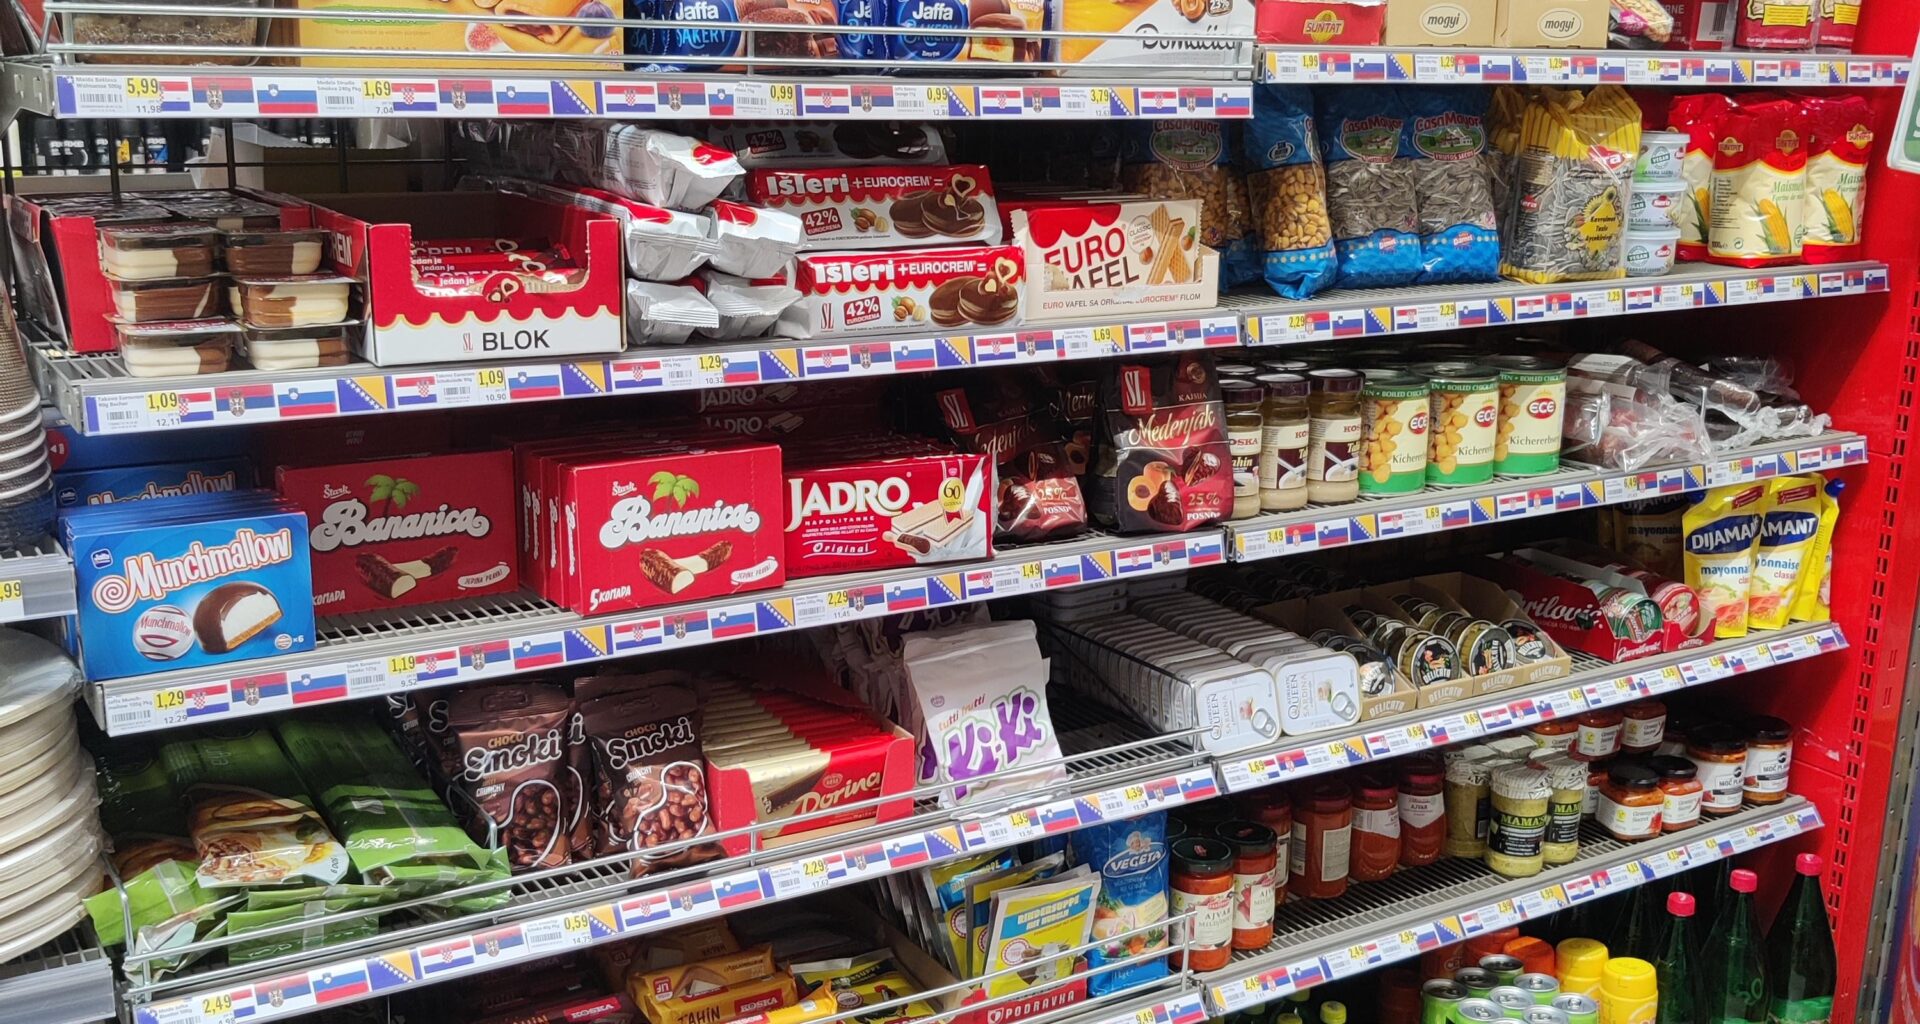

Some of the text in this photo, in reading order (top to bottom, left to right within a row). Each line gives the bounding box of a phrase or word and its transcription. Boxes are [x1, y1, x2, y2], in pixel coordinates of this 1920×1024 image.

[676, 1, 719, 21] Jaffa
[912, 1, 953, 21] Jaffa
[1305, 21, 1343, 34] SUNTAT
[1427, 12, 1461, 29] mogyi
[1544, 17, 1576, 32] mogyi
[126, 77, 160, 97] 5,99
[363, 80, 391, 97] 1,69
[770, 84, 794, 100] 0,99
[926, 87, 948, 102] 0,99
[1089, 88, 1109, 103] 3,79
[136, 105, 162, 114] 11,98
[1414, 111, 1482, 131] CasaMayor
[750, 131, 782, 147] 42%
[766, 173, 850, 195] Išleri
[804, 209, 839, 227] 42%
[1044, 226, 1126, 274] EURO
[421, 264, 455, 272] jedan je
[1072, 256, 1140, 289] AFEL
[440, 277, 475, 287] jedan je
[846, 298, 879, 317] 42%
[1042, 301, 1064, 310] EURO
[1065, 299, 1088, 309] VAFEL
[1089, 298, 1099, 307] SA
[1179, 292, 1201, 302] FILOM
[820, 302, 834, 331] SL
[1440, 304, 1455, 318] 2,29
[1289, 315, 1306, 329] 2,29
[482, 329, 551, 352] BLOK
[1093, 329, 1111, 342] 1,69
[699, 354, 722, 372] 1,29
[478, 369, 505, 387] 1,09
[1124, 370, 1147, 408] SL
[148, 391, 179, 410] 1,09
[1530, 402, 1555, 416] ECE
[943, 392, 968, 431] SL
[1476, 408, 1496, 424] ECE
[156, 417, 181, 428] 12,11
[1128, 404, 1216, 446] Medenjak
[1410, 415, 1428, 431] ECE
[1229, 437, 1258, 446] OSKA
[1232, 456, 1253, 467] ahin
[943, 480, 961, 500] 60
[784, 476, 911, 533] JADRO
[1424, 506, 1440, 520] 1,69
[310, 497, 491, 552] Bananica
[600, 495, 761, 549] Bananica
[805, 515, 875, 526] NAPOLITANKE
[1266, 528, 1284, 544] 3,49
[812, 542, 869, 554] Original
[92, 528, 293, 614] Munchmallow
[1021, 563, 1041, 579] 1,49
[590, 585, 632, 612] 5 KOMADA
[827, 590, 849, 606] 2,29
[139, 615, 192, 636] Munchmallow
[391, 656, 416, 672] 1,19
[1422, 668, 1451, 685] DELICATO
[1530, 665, 1562, 682] DELICATO
[401, 679, 419, 688] 9,52
[1481, 674, 1515, 691] DELICATO
[156, 689, 185, 710] 1,29
[1287, 673, 1300, 720] QUEEN
[1300, 673, 1309, 717] SARDINA
[1428, 687, 1463, 704] DELICATO
[938, 693, 987, 733] tutti frutti
[1369, 701, 1406, 718] DELICATO
[1463, 711, 1479, 725] 0,69
[163, 713, 188, 725] 12,29
[624, 723, 658, 738] CHOCO
[1406, 724, 1422, 739] 0,69
[488, 733, 525, 749] CHOCO
[606, 716, 696, 770] Smoki
[1328, 742, 1344, 755] 1,69
[463, 729, 562, 782] Smoki
[626, 766, 653, 782] CRUNCHY
[1248, 759, 1265, 774] 1,69
[475, 782, 506, 798] CRUNCHY
[797, 771, 882, 815] Dorina
[1125, 786, 1144, 800] 1,39
[1009, 811, 1029, 828] 1,39
[803, 858, 825, 877] 2,29
[1109, 849, 1163, 873] VEGETA
[1204, 908, 1231, 920] AJVAR
[563, 914, 589, 932] 0,59
[572, 934, 593, 945] 14,75
[1397, 929, 1416, 943] 2,99
[1347, 945, 1365, 960] 2,49
[1242, 976, 1261, 991] 2,49
[203, 994, 232, 1015] 2,49
[571, 1002, 615, 1019] KOSKA
[739, 996, 778, 1013] KOSKA
[1005, 989, 1076, 1022] PODRAVKA
